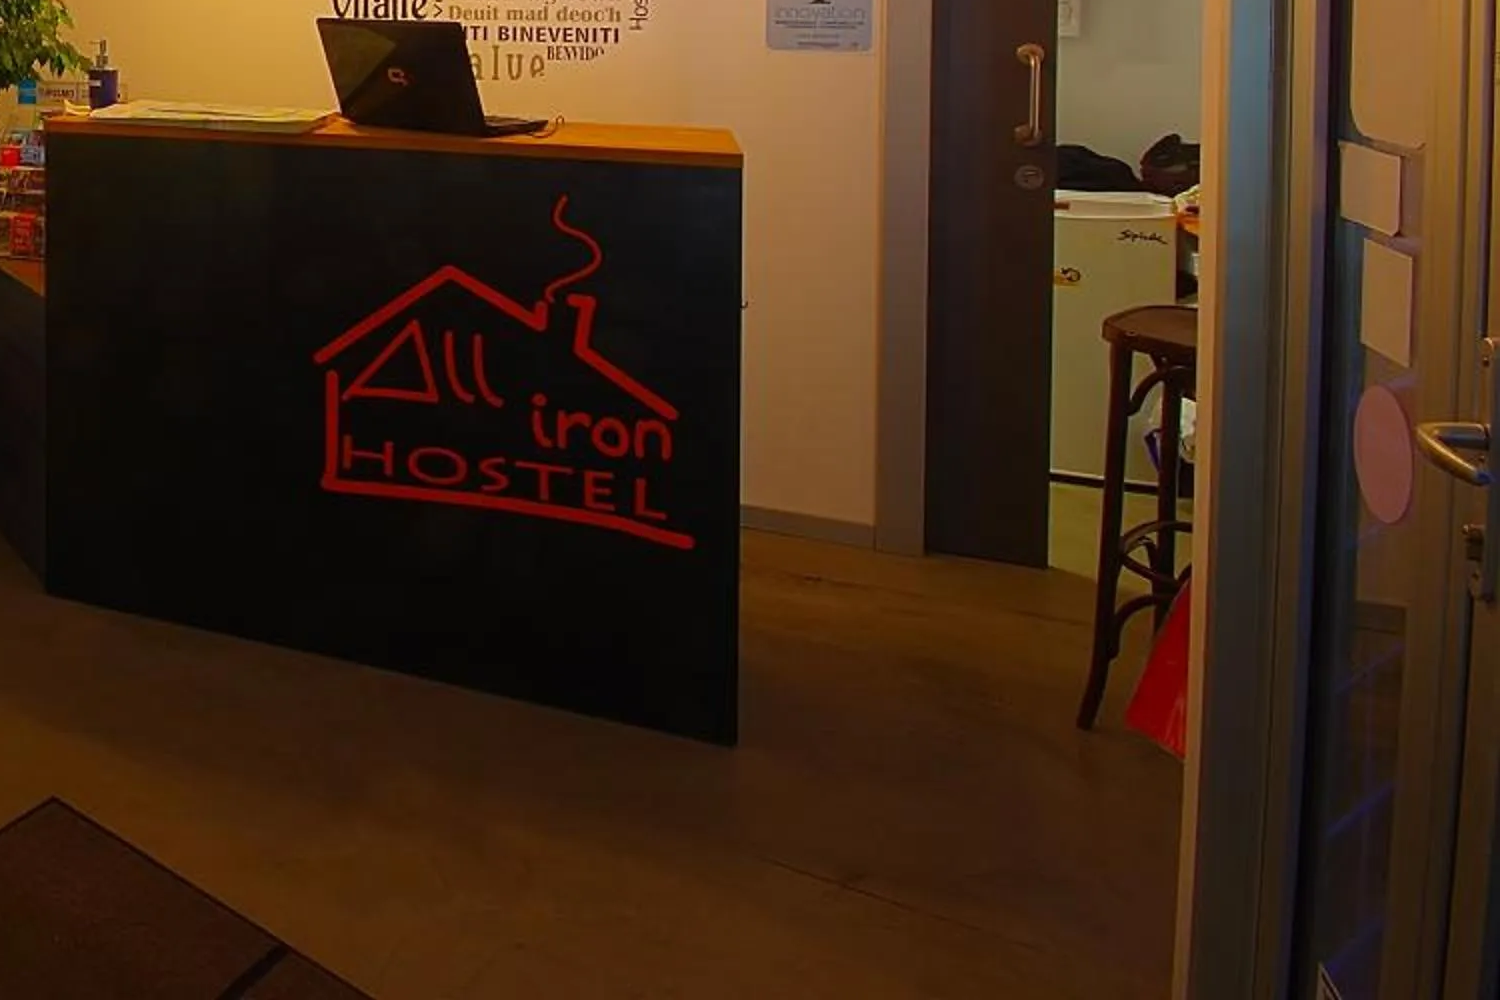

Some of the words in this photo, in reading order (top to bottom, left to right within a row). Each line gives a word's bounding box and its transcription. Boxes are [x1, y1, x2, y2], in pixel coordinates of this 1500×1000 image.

[448, 6, 499, 23] Deuit
[506, 2, 549, 23] mad
[342, 319, 505, 409] All
[531, 393, 672, 461] iron
[342, 435, 667, 521] HOSTEL
